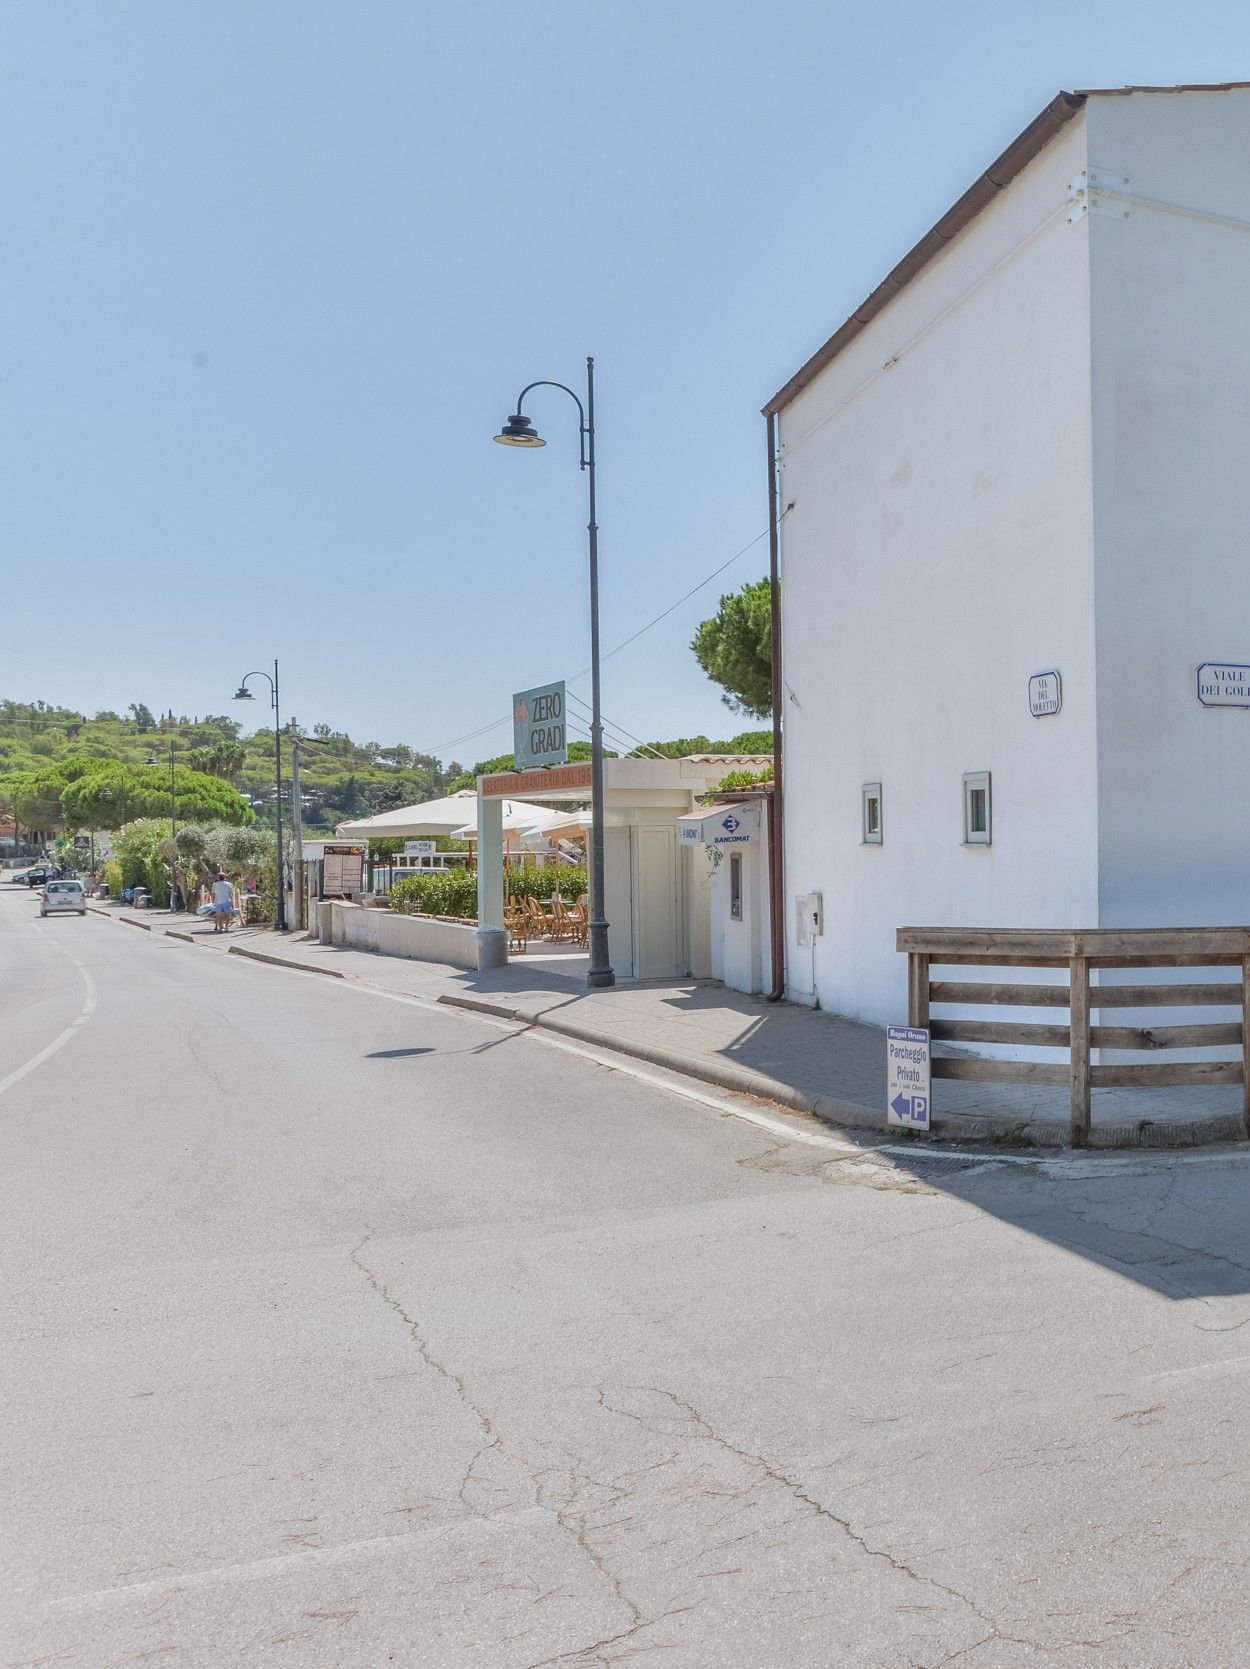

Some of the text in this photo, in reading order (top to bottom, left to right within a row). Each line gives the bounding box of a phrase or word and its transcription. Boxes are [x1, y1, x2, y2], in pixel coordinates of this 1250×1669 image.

[1214, 670, 1246, 681] VIALE
[1201, 685, 1220, 695] DEI
[531, 692, 561, 723] ZERO
[530, 724, 565, 755] GRADI
[520, 771, 559, 789] GRANITERIA
[561, 768, 575, 786] DAL
[577, 766, 592, 784] 198
[714, 835, 751, 844] BANCOMAT
[890, 1044, 927, 1064] Parcheggio
[897, 1066, 920, 1082] Privato
[914, 1097, 925, 1119] P
